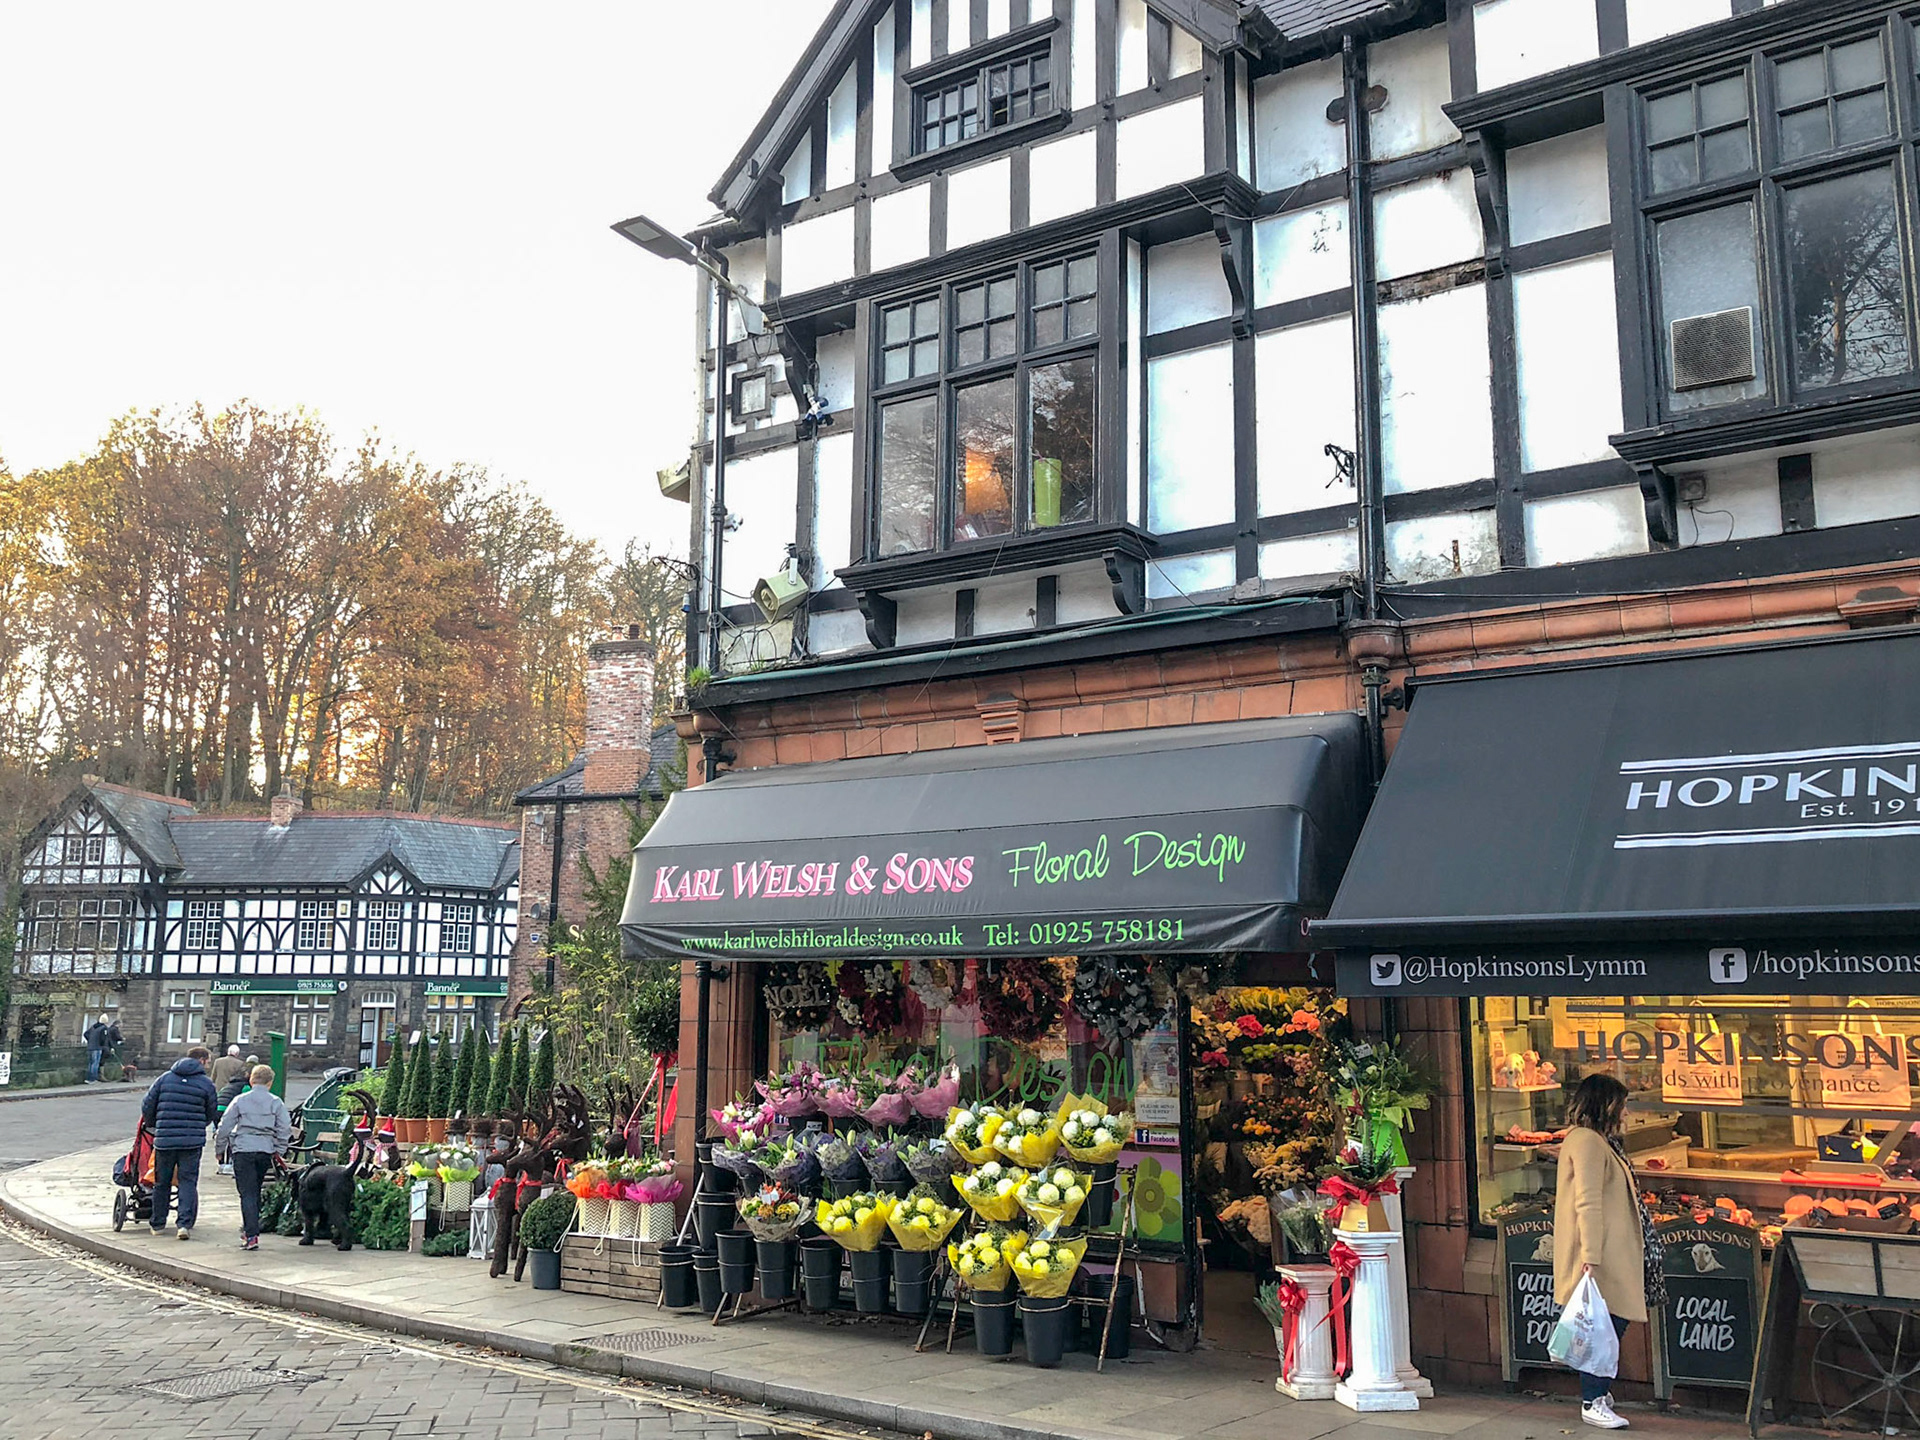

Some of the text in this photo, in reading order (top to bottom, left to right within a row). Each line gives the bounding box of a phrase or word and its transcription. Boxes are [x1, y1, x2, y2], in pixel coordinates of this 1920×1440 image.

[1626, 764, 1917, 810] HOPKIN
[1801, 802, 1854, 819] Est.
[1002, 830, 1246, 887] Floral Design
[845, 855, 879, 896] &
[681, 918, 1185, 951] www.karlwelshfloraldesign.co.uk Tel: 01925 758181
[1403, 954, 1648, 984] @HopkinsonsLymm
[213, 980, 250, 991] Banner
[427, 982, 460, 992] Banner
[1691, 1069, 1740, 1088] with
[1659, 1229, 1752, 1250] HOPKINSONS
[1676, 1296, 1737, 1322] LOCAL
[1680, 1321, 1736, 1352] LAMB
